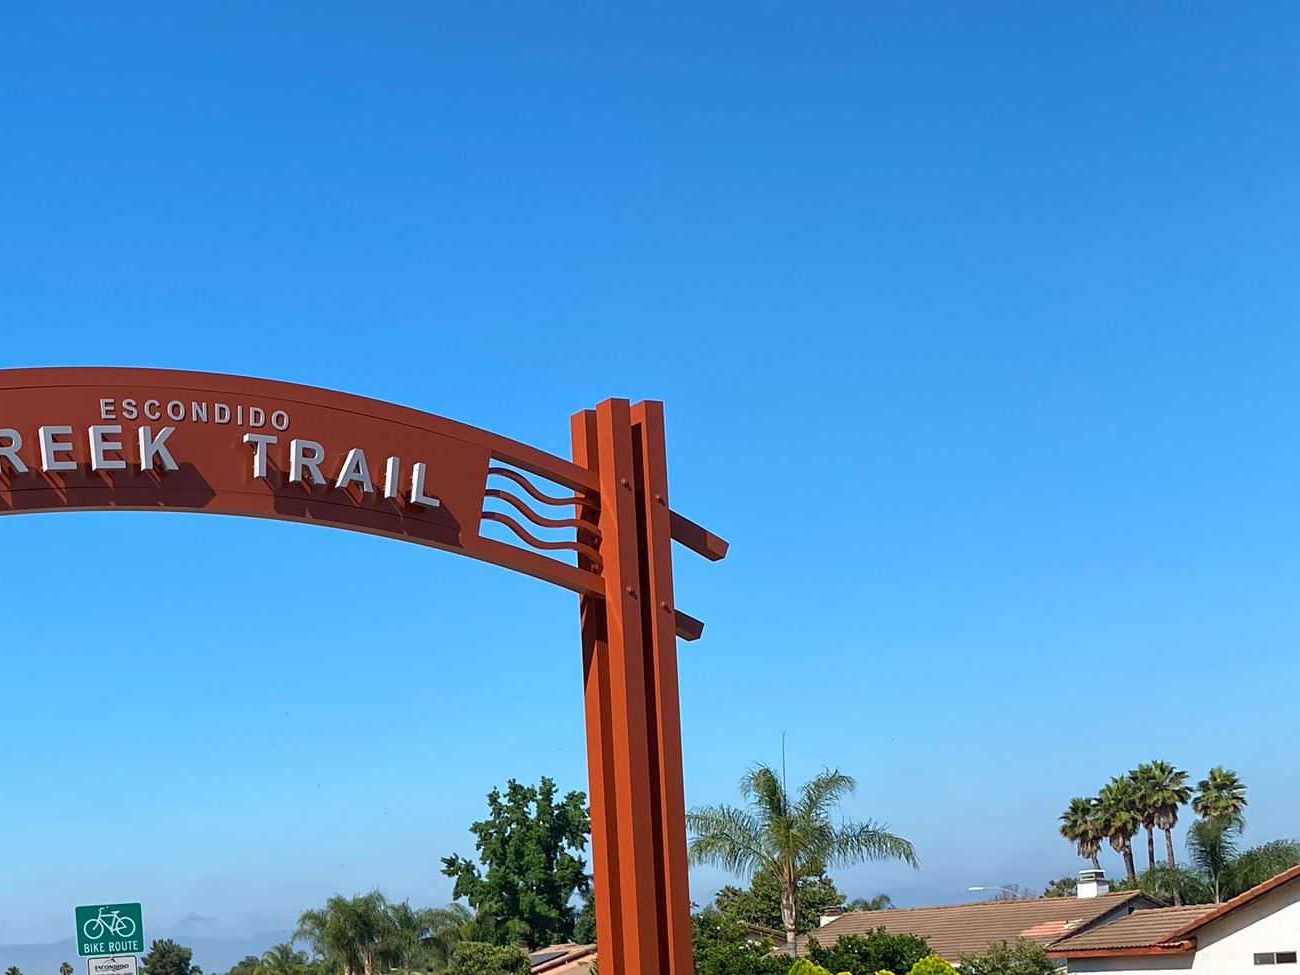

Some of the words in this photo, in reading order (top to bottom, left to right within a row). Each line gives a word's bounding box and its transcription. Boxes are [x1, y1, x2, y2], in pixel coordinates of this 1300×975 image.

[99, 398, 290, 432] ESCONDIDO
[243, 433, 440, 508] TRAIL
[84, 942, 105, 954] BIKE
[108, 941, 138, 952] ROUTE
